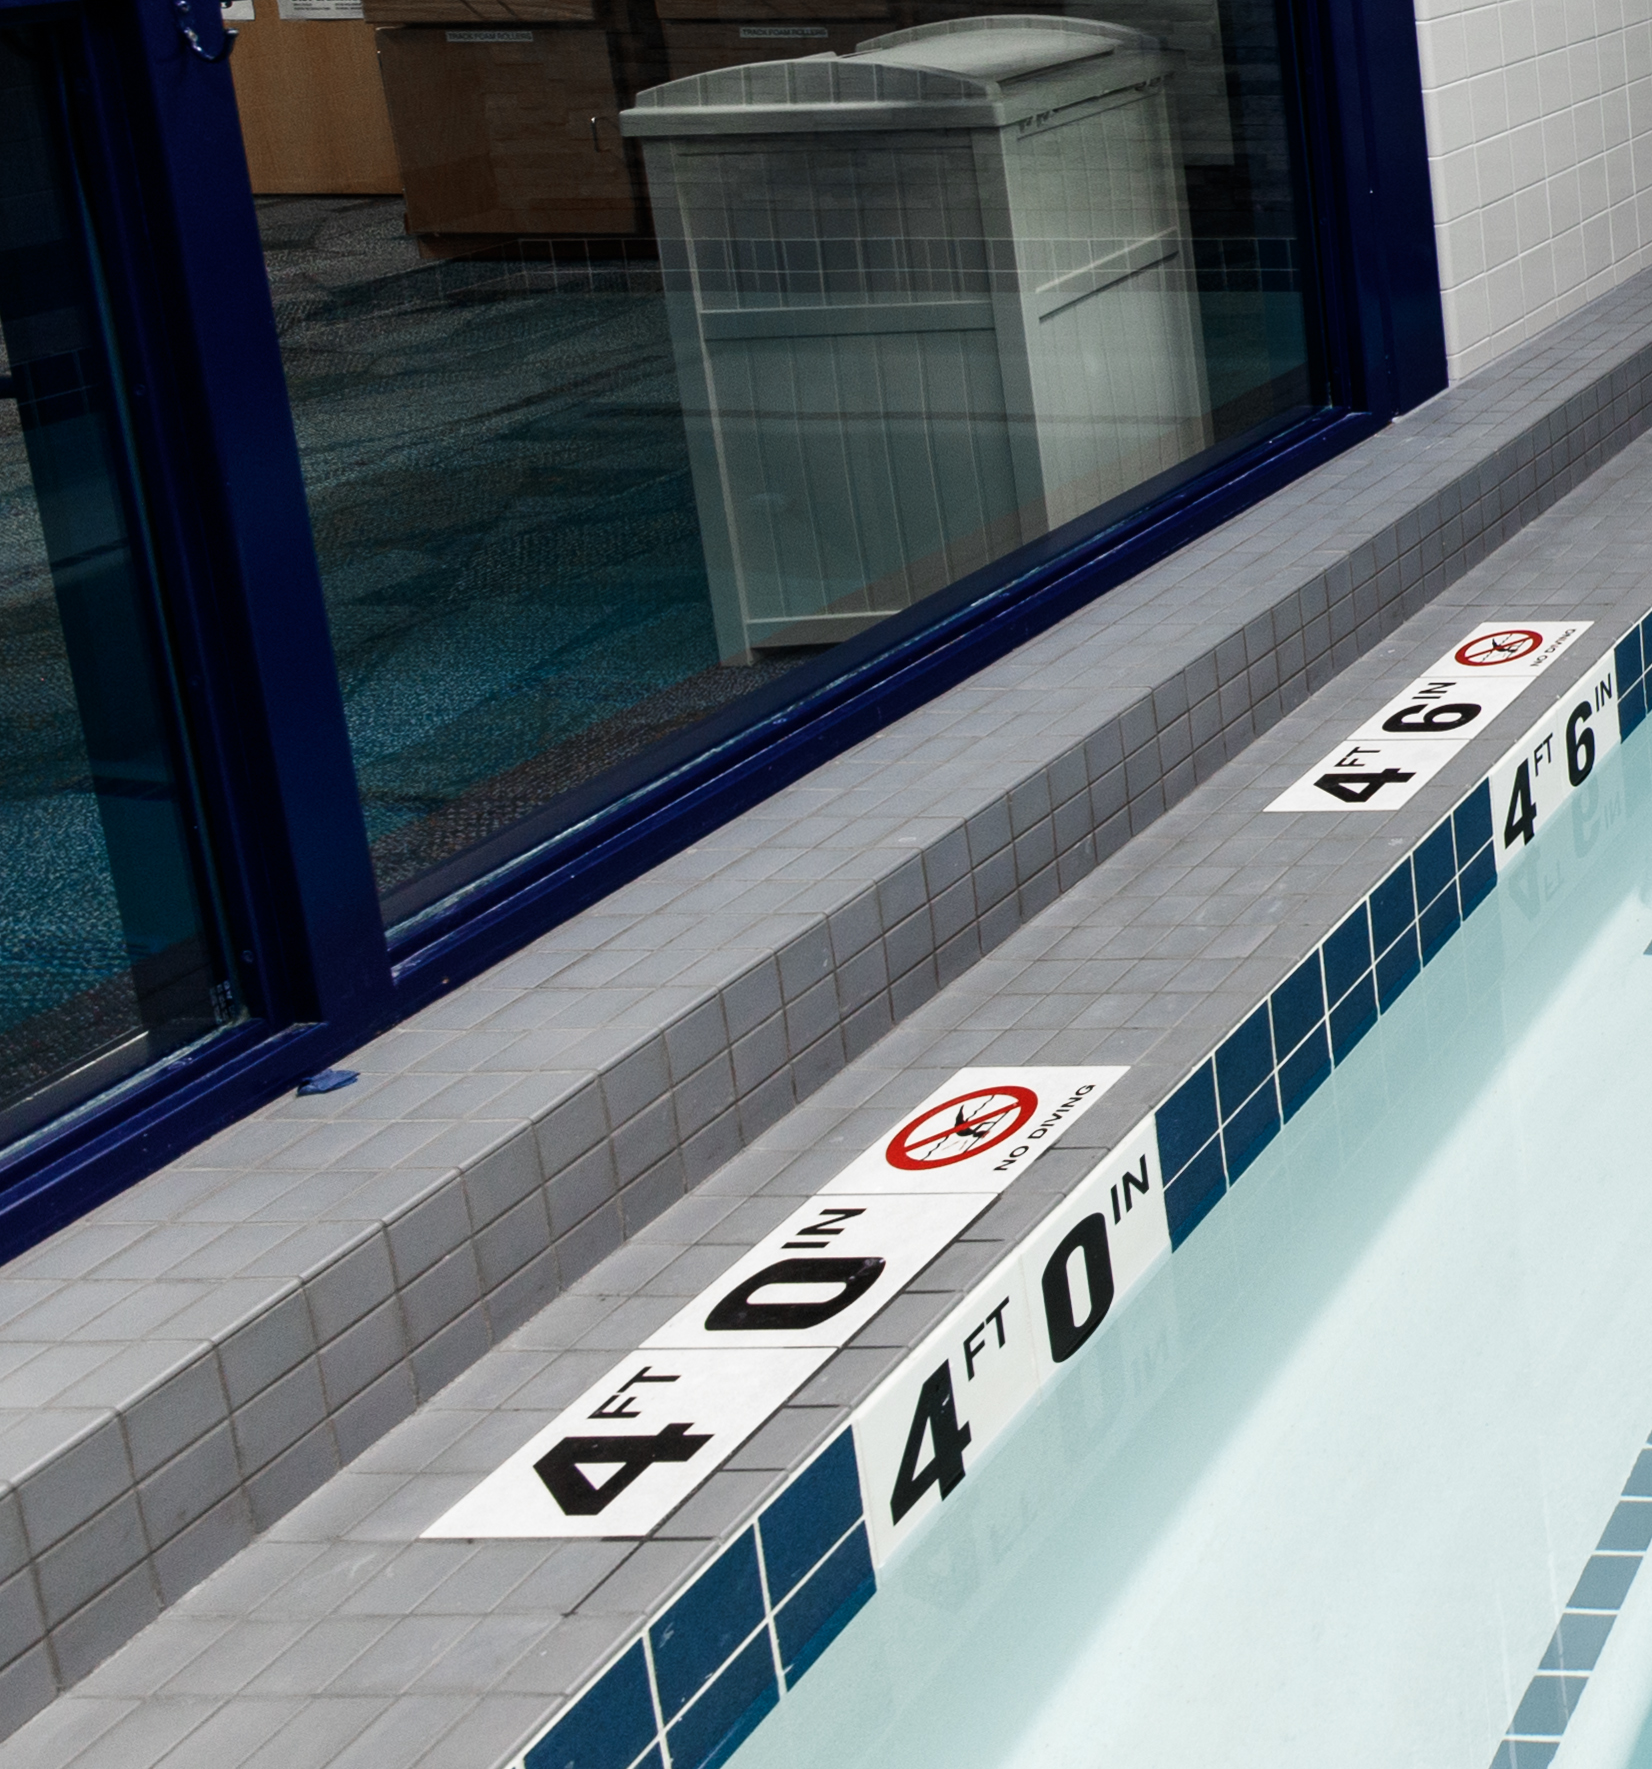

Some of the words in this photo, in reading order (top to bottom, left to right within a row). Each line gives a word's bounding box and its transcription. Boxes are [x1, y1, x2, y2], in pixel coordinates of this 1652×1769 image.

[1530, 654, 1548, 667] NO
[993, 1145, 1030, 1172] NO
[1027, 1084, 1097, 1140] DIVING
